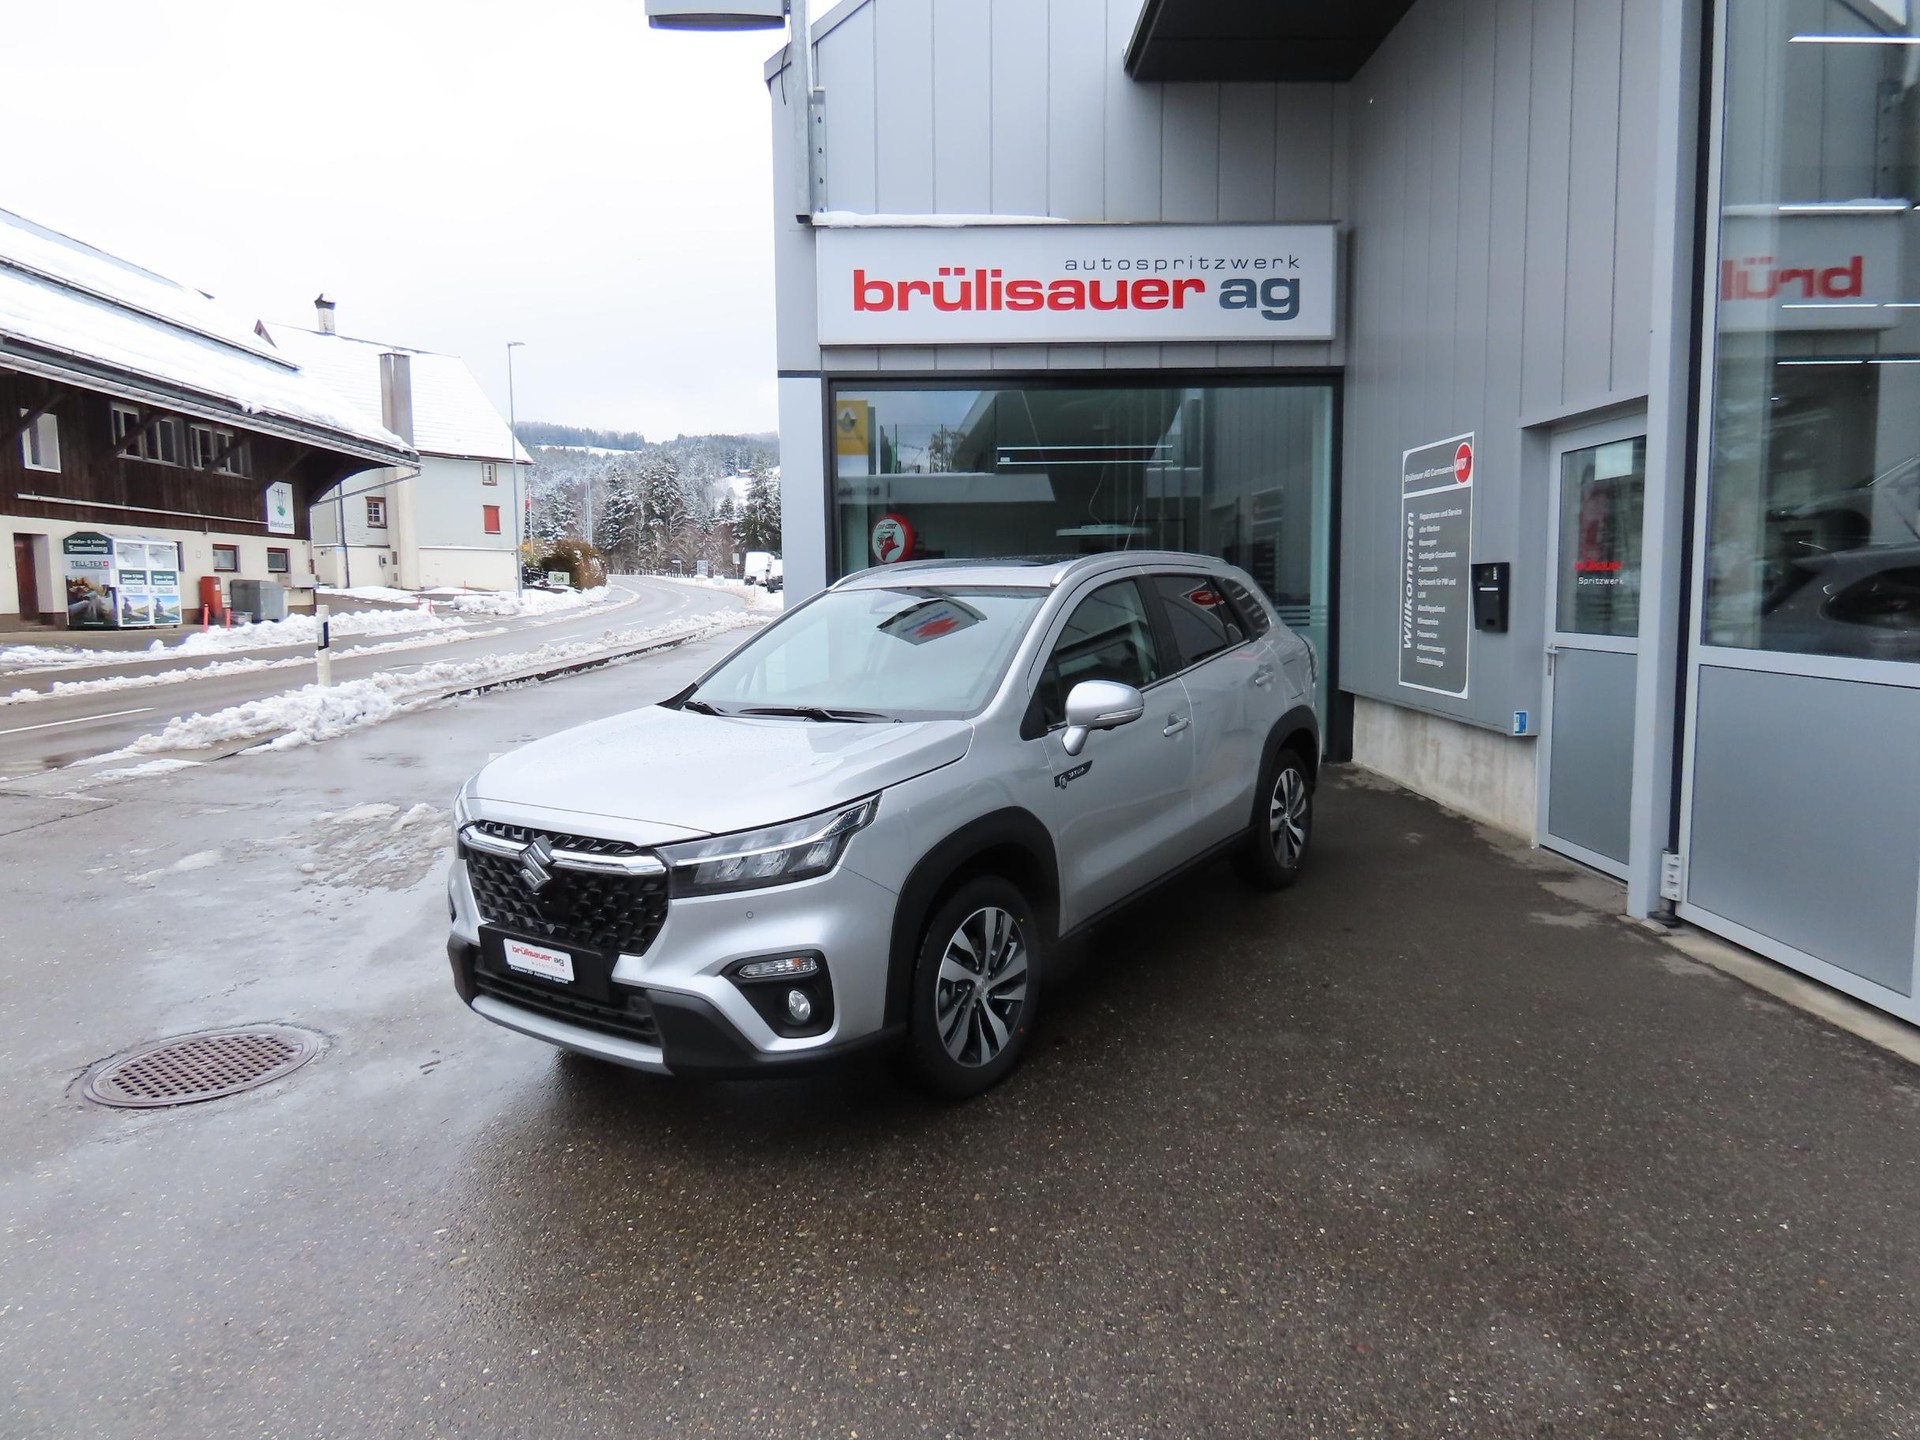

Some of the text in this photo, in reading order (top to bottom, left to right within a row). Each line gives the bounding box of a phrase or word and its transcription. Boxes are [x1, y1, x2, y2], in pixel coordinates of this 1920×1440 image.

[1065, 255, 1300, 271] autospritzwerk
[853, 267, 1300, 321] brülisauer ag
[1578, 576, 1624, 585] Spritzwerk
[512, 945, 565, 967] brülisauer ag
